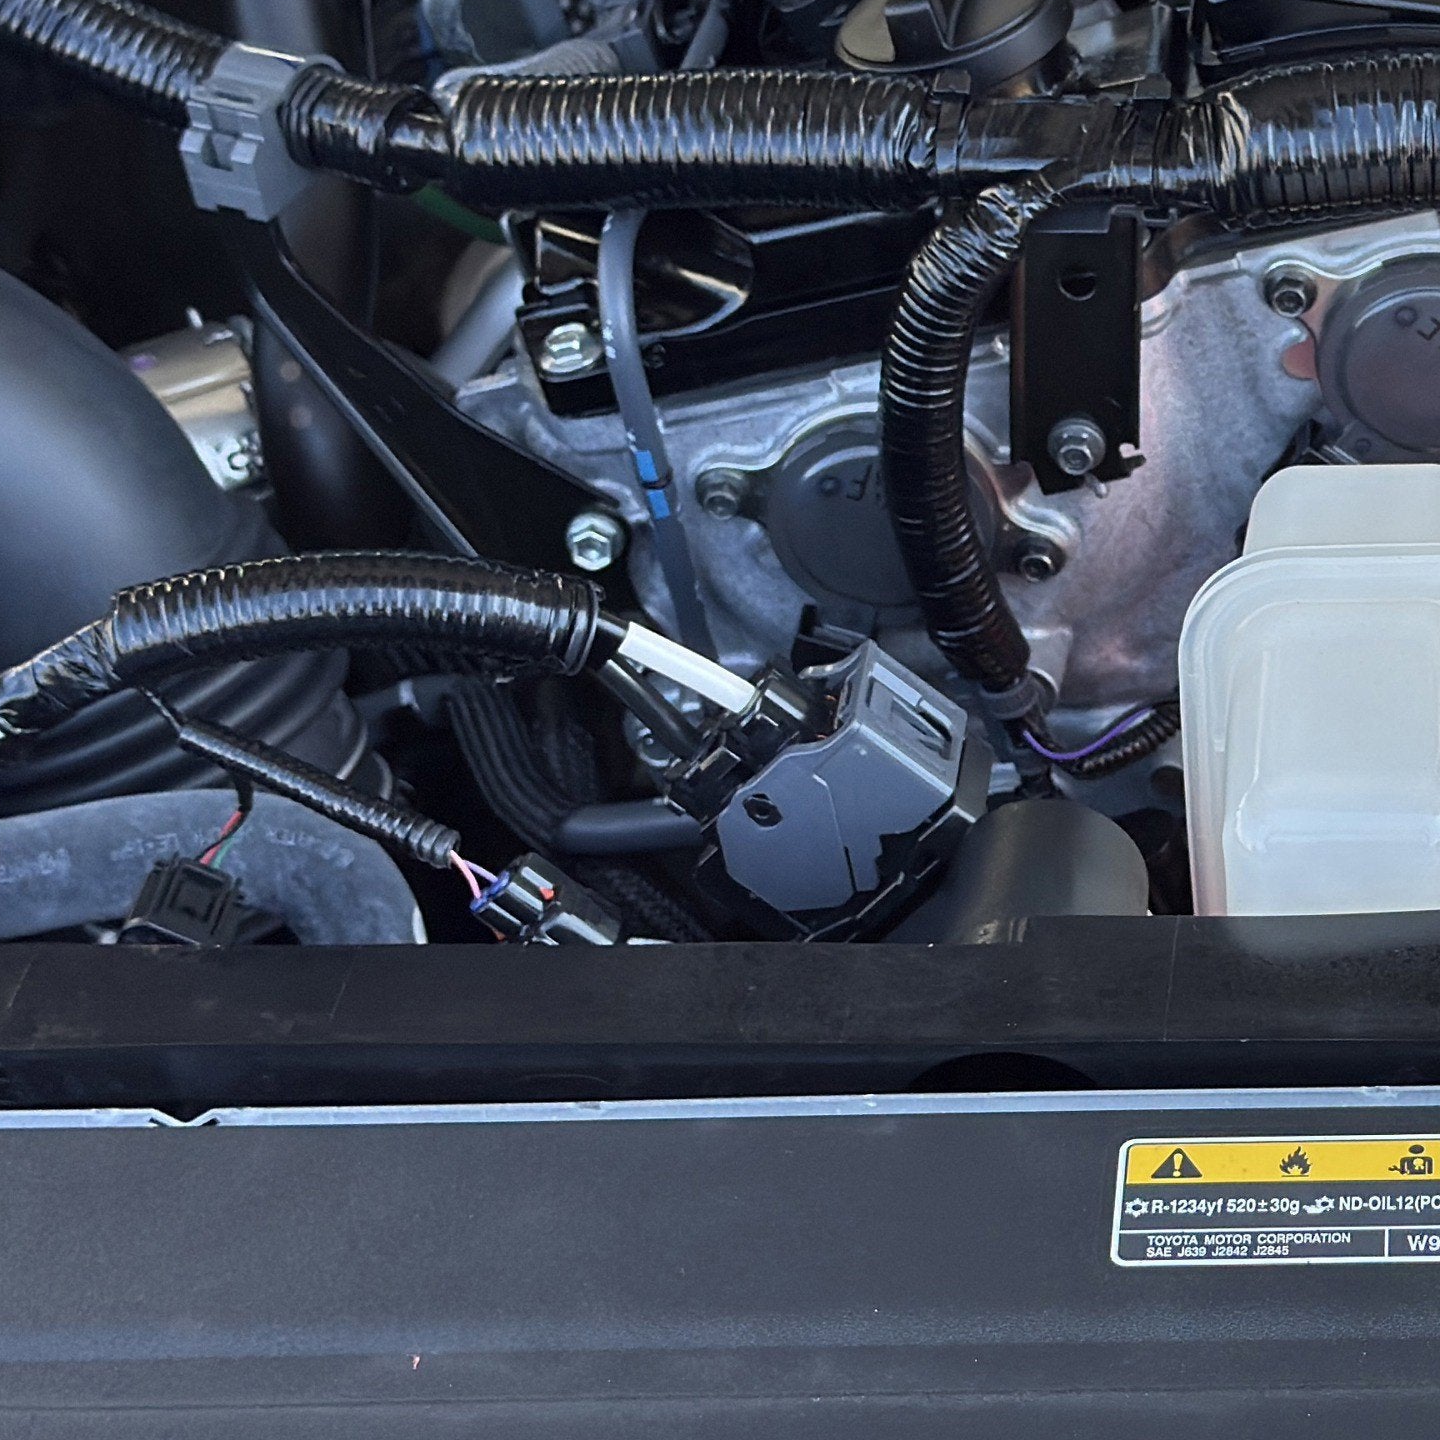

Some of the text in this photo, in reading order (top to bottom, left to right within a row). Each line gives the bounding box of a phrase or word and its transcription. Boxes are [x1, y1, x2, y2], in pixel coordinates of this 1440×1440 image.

[1152, 1198, 1301, 1216] R-1234yf 520±30g
[1147, 1232, 1351, 1246] TOYOTA MOTOR CORPORATION
[1407, 1234, 1440, 1252] W9
[1146, 1245, 1290, 1258] SAE J639 J2842 J2845
